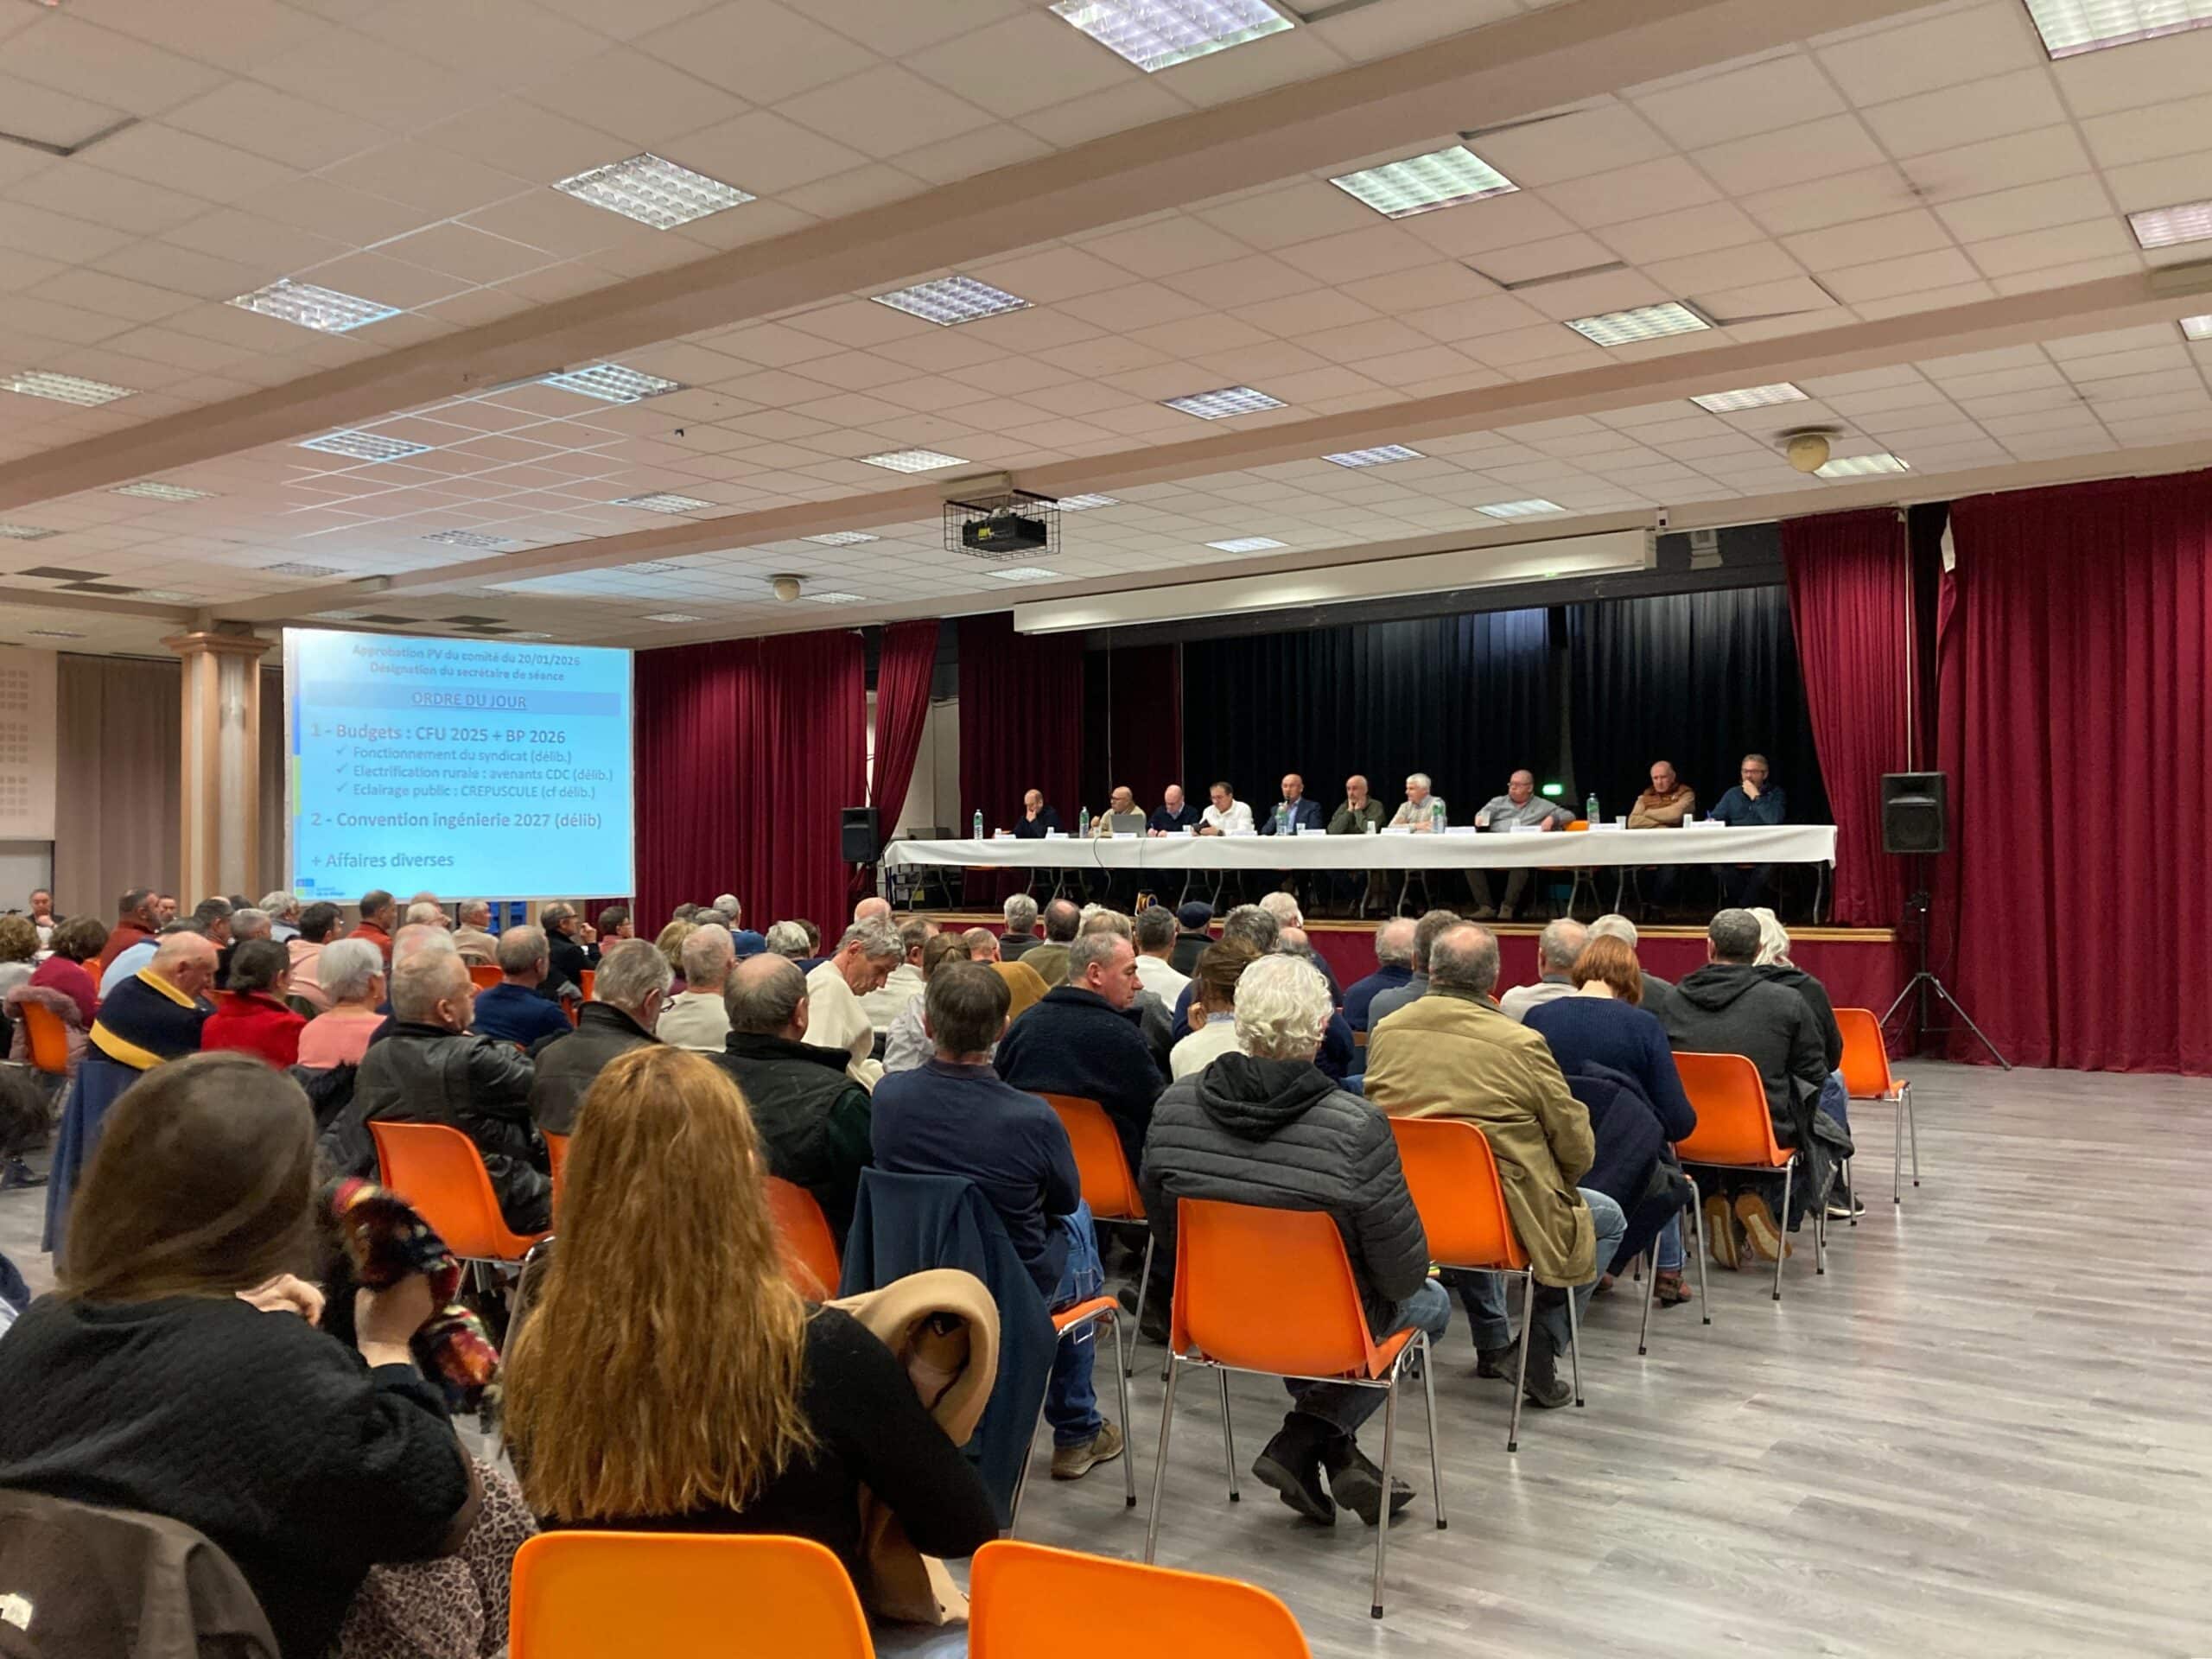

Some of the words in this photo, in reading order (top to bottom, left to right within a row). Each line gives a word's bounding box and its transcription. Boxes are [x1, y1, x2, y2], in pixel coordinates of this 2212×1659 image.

[428, 649, 443, 658] PV
[445, 649, 459, 660] du
[461, 651, 499, 663] comité
[501, 652, 515, 663] du
[518, 654, 581, 665] 20/01/2026
[370, 662, 436, 676] Désignation
[440, 664, 454, 676] du
[457, 667, 510, 679] secrétaire
[512, 669, 525, 680] de
[528, 670, 564, 681] séance
[412, 692, 461, 706] ORDRE
[466, 694, 486, 706] DU
[490, 695, 526, 709] JOUR
[311, 724, 321, 737] 1
[337, 723, 402, 741] Budgets
[416, 727, 446, 741] CFU
[451, 728, 488, 742] 2025
[505, 729, 525, 742] BP
[530, 731, 566, 744] 2026
[353, 747, 456, 760] Fonctionnement
[460, 748, 474, 760] du
[479, 749, 527, 765] syndicat
[442, 767, 479, 779] rurale
[489, 769, 543, 780] avenants
[545, 769, 569, 780] CDC
[413, 785, 450, 798] public
[461, 785, 537, 798] CREPUSCULE
[541, 785, 556, 799] (cf
[311, 812, 321, 827] 2
[337, 812, 429, 827] Convention
[433, 811, 511, 830] ingénierie
[514, 813, 550, 827] 2027
[555, 812, 601, 830] (délib)
[325, 852, 387, 868] Affaires
[391, 852, 454, 868] diverses
